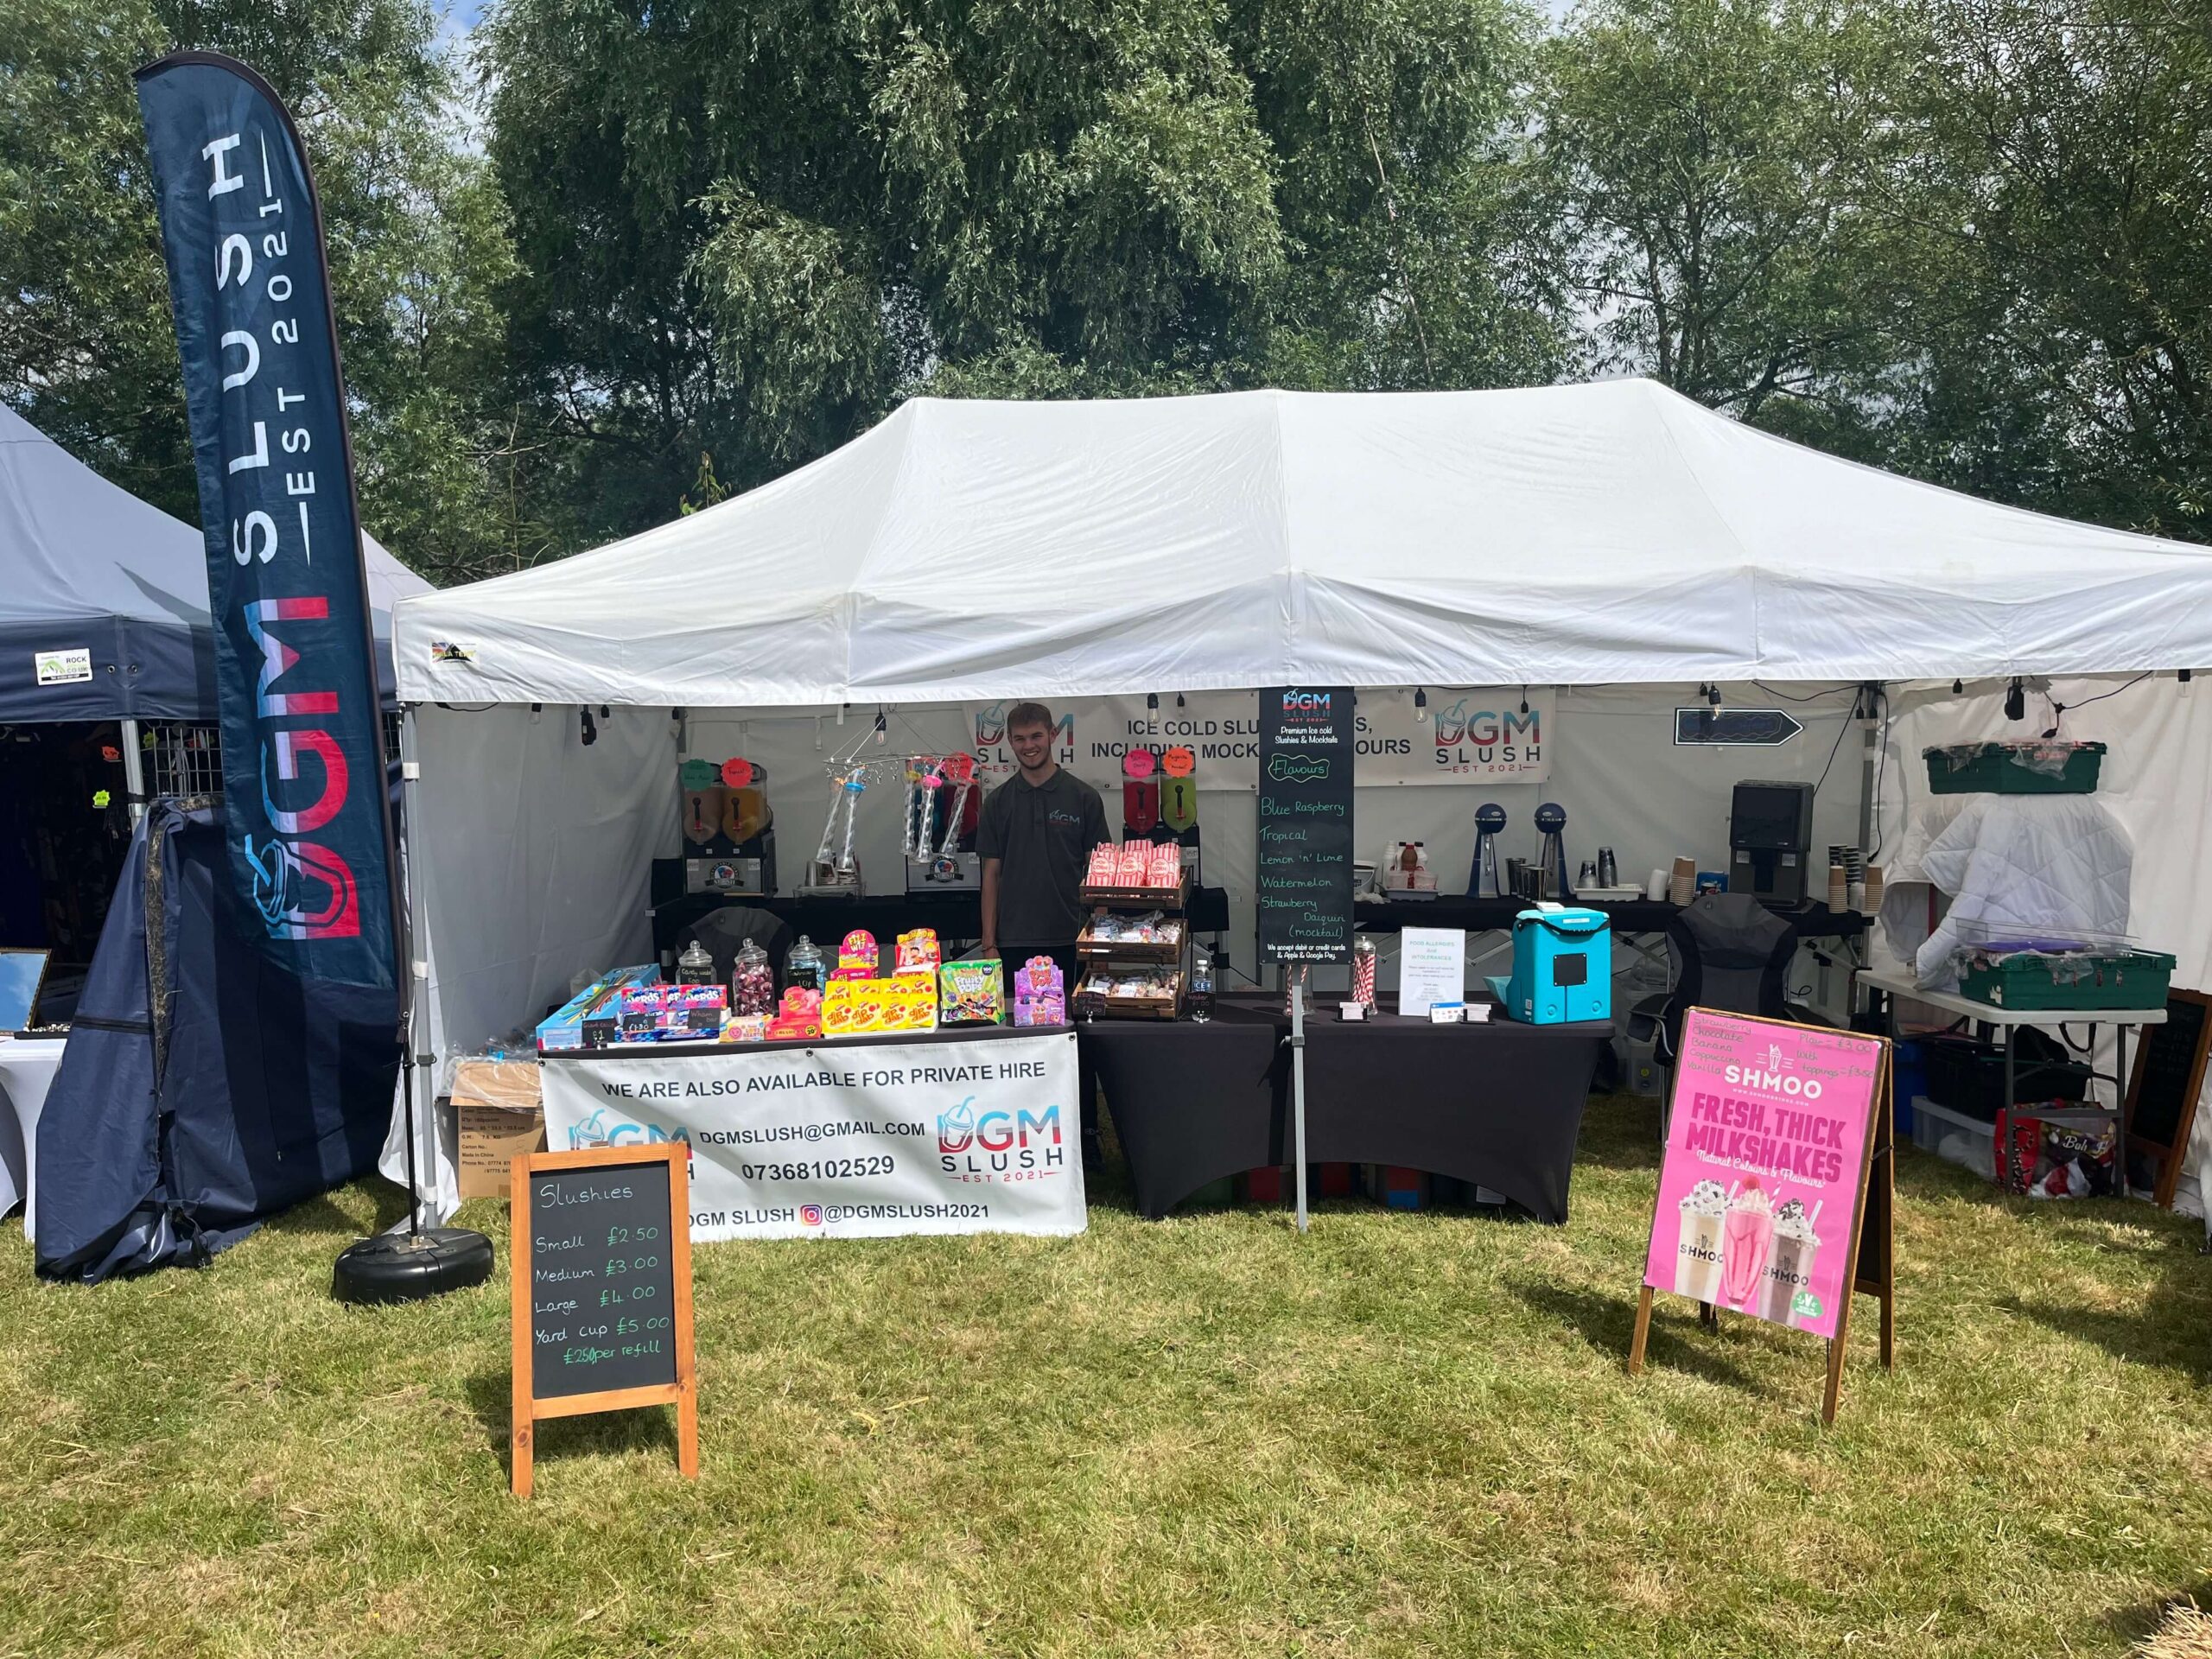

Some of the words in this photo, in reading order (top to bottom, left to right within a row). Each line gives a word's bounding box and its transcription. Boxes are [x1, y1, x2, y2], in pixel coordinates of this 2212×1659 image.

[259, 198, 300, 345] 2021
[202, 133, 279, 566] SLUSH
[277, 386, 316, 496] EST
[1283, 692, 1331, 710] DGM
[1128, 720, 1159, 734] ICE
[1165, 721, 1217, 735] COLD
[1281, 726, 1307, 734] Premium
[1308, 726, 1319, 734] Ice
[1319, 726, 1332, 734] cold
[1435, 708, 1540, 747] DGM
[1202, 743, 1259, 759] MOCK
[1355, 739, 1411, 755] OURS
[1274, 735, 1299, 744] Slushies
[1308, 735, 1338, 744] Mocktails
[978, 748, 1074, 763] SLH
[1435, 747, 1541, 764] SLUSH
[244, 596, 360, 940] DGM
[1274, 760, 1325, 775] Flavours
[1488, 764, 1523, 772] 2021
[1261, 797, 1290, 816] Blue
[1295, 801, 1344, 817] Raspberry
[1259, 825, 1308, 844] Tropical
[1261, 852, 1294, 864] Lemon
[1317, 853, 1344, 862] Lime
[1261, 874, 1332, 888] Watermelon
[1261, 896, 1318, 911] Strawberry
[1288, 925, 1344, 939] (mocktail)
[1277, 944, 1294, 952] accept
[1283, 951, 1299, 960] Apple
[1306, 951, 1324, 960] Google
[1692, 1025, 1744, 1043] Chocolate
[1694, 1015, 1751, 1035] Strawberry
[1691, 1037, 1733, 1052] Banana
[602, 1083, 633, 1098] WE
[639, 1081, 680, 1098] ARE
[685, 1079, 741, 1096] ALSO
[747, 1071, 857, 1092] AVAILABLE
[862, 1070, 905, 1087] FOR
[911, 1065, 994, 1084] PRIVATE
[999, 1061, 1046, 1079] HIRE
[1724, 1065, 1823, 1099] SHMOO
[937, 1103, 1062, 1154] DGM
[1691, 1091, 1771, 1137] FRESH,
[1775, 1108, 1847, 1150] THICK
[699, 1121, 926, 1145] DGMSLUSH@GMAIL.COM
[942, 1147, 1064, 1173] SLUSH
[1685, 1121, 1843, 1183] MILKSHAKES
[741, 1154, 895, 1180] 07368102529
[1696, 1149, 1732, 1168] Natural
[1732, 1157, 1770, 1176] Colours
[1770, 1166, 1777, 1178] &
[962, 1173, 993, 1183] EST
[1003, 1170, 1045, 1182] 2021
[539, 1183, 633, 1209] Slushies
[732, 1208, 795, 1225] SLUSH
[823, 1203, 989, 1224] @DGMSLUSH2021
[536, 1235, 585, 1254] Small
[607, 1226, 659, 1248] £2.50
[1680, 1243, 1724, 1263] SHMOO
[536, 1268, 595, 1284] Medium
[605, 1256, 658, 1278] £3.00
[1762, 1265, 1809, 1287] SHMOO
[535, 1298, 579, 1315] Large
[600, 1286, 656, 1308] £4.00
[535, 1327, 569, 1345] Yard
[579, 1324, 608, 1339] cup
[616, 1316, 671, 1336] £5.00
[621, 1339, 662, 1358] refill
